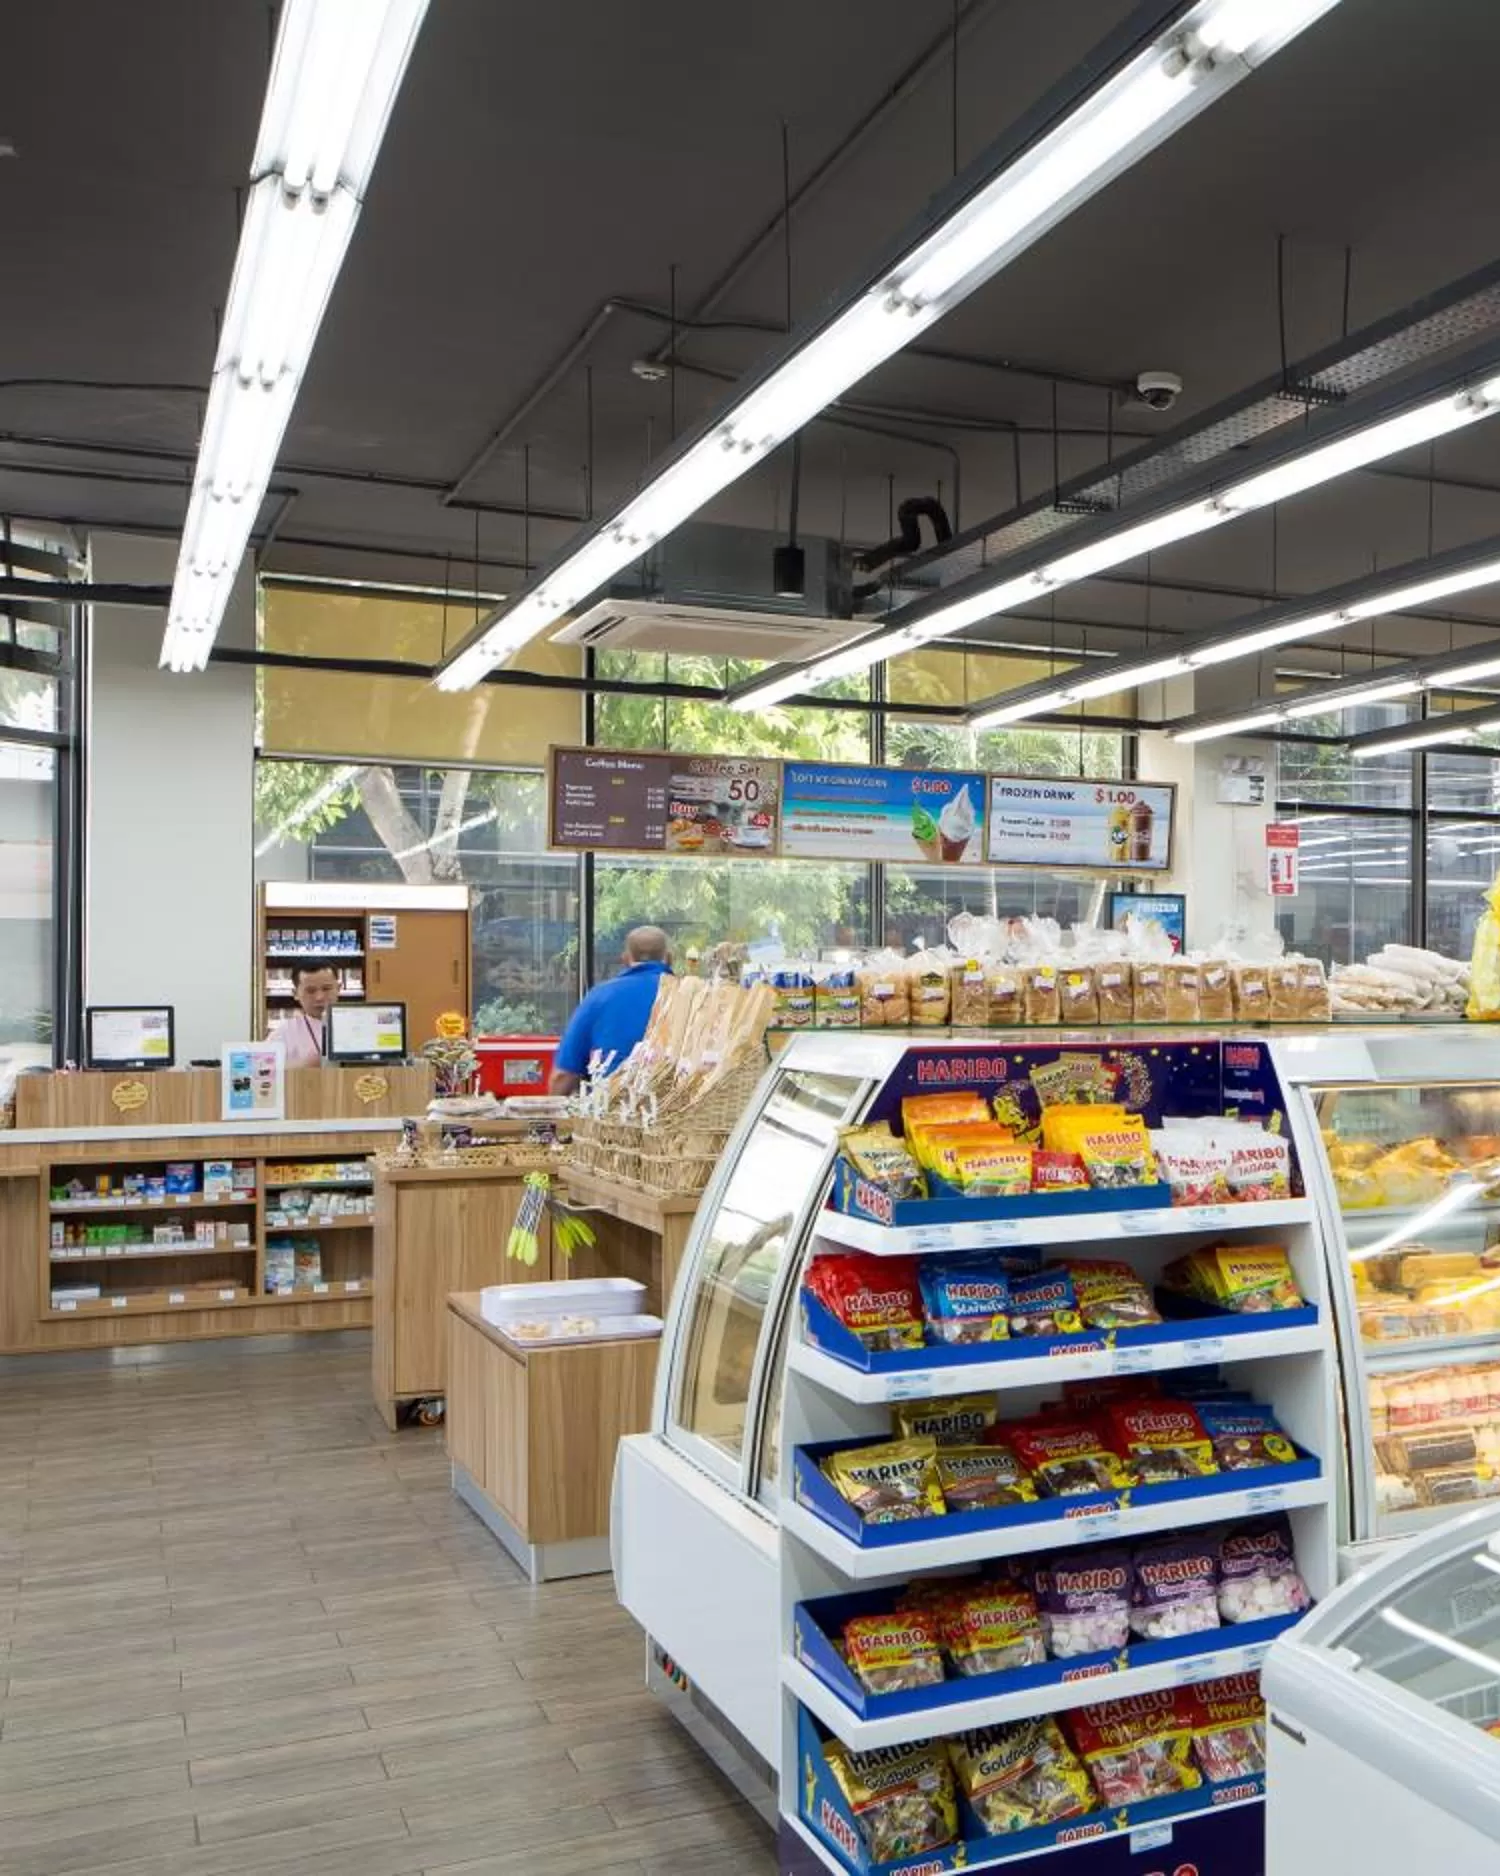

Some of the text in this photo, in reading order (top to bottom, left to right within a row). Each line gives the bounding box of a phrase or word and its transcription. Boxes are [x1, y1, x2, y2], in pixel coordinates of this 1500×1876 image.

[689, 759, 761, 776] Coffee Set
[728, 779, 760, 801] 50
[1001, 787, 1075, 801] FROZEN DRINK
[917, 1057, 1007, 1083] HARIBO
[1086, 1131, 1142, 1147] HARIBO
[844, 1290, 913, 1312] HARIBO
[945, 1282, 1004, 1300] HARIBO
[914, 1411, 985, 1435] HARIBO
[1126, 1411, 1194, 1432] HARIBO
[850, 1458, 926, 1483] HARIBO
[1056, 1566, 1127, 1593] HARIBO
[1142, 1555, 1214, 1586] HARIBO
[970, 1605, 1032, 1627] HARIBO
[858, 1627, 927, 1650] HARIBO
[1191, 1671, 1262, 1703] HARIB
[1083, 1689, 1176, 1728] HARIBO
[849, 1738, 931, 1775] HARIBO
[864, 1756, 935, 1792] Goldbears
[1211, 1783, 1257, 1803] HARIBO
[1055, 1821, 1107, 1845] HARIBO
